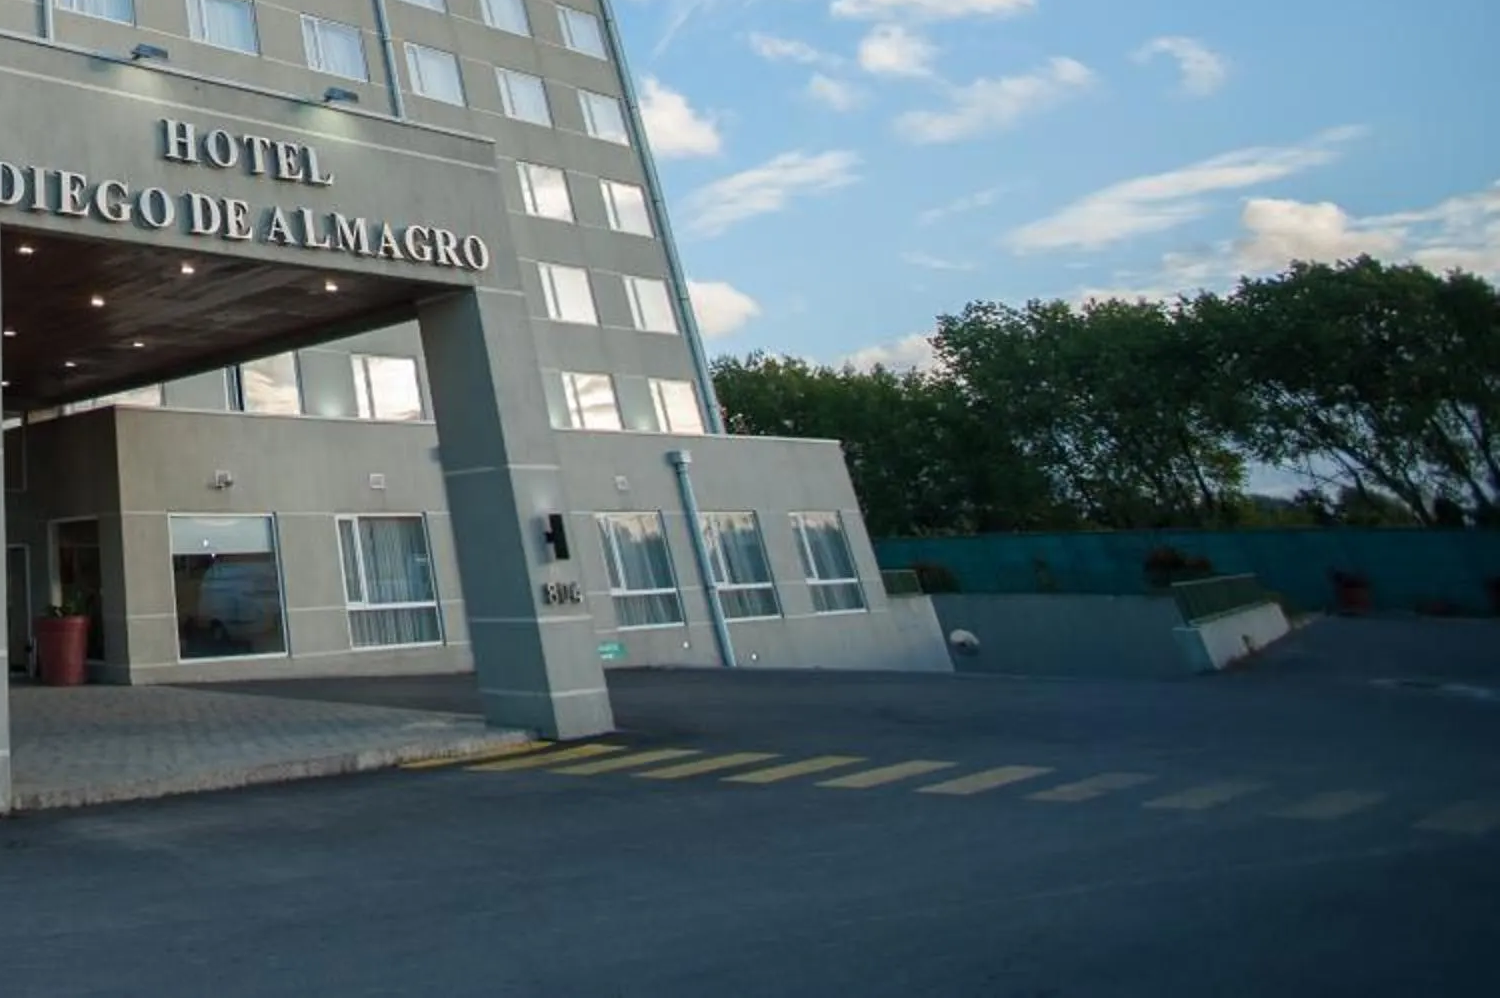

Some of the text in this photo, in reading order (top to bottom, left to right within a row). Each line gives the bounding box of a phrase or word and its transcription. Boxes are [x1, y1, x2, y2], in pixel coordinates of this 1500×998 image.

[163, 119, 334, 186] HOTEL
[190, 193, 253, 241] DE
[267, 207, 490, 271] ALMAGRO
